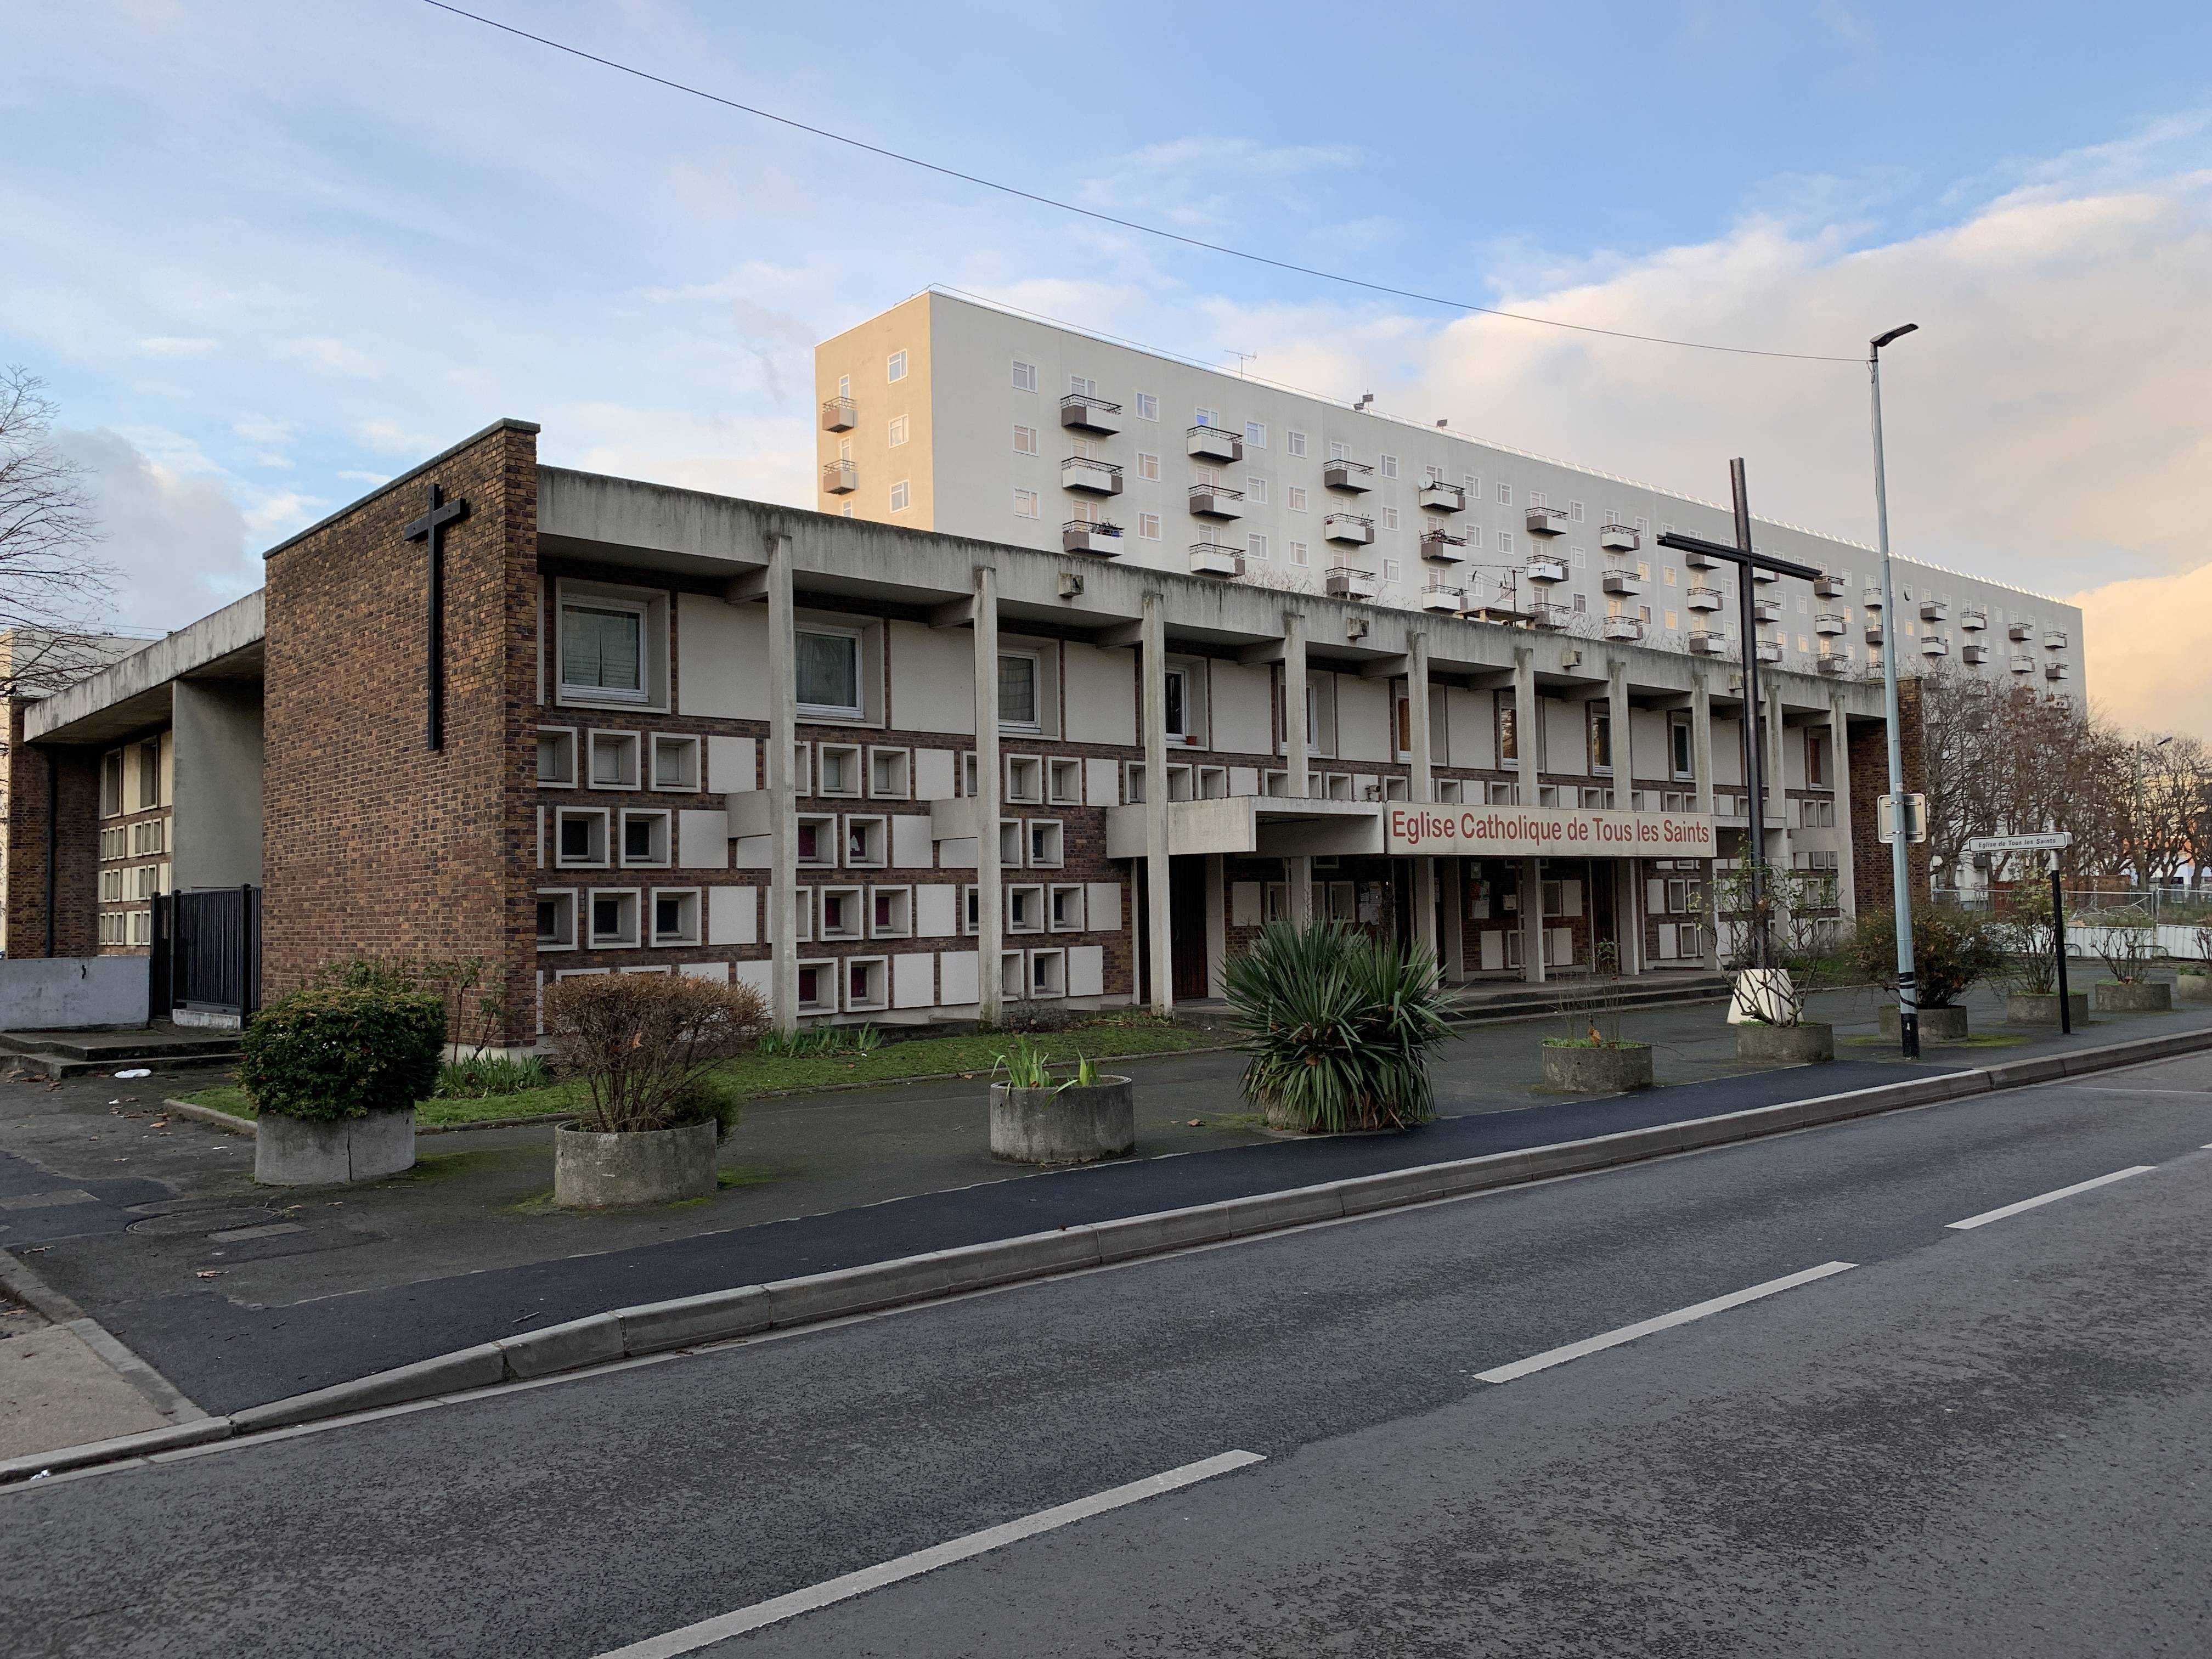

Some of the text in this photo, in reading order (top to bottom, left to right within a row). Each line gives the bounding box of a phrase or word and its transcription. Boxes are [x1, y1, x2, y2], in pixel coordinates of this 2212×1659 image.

[1392, 811, 1709, 845] Eglise Catholique de Tous les Saints
